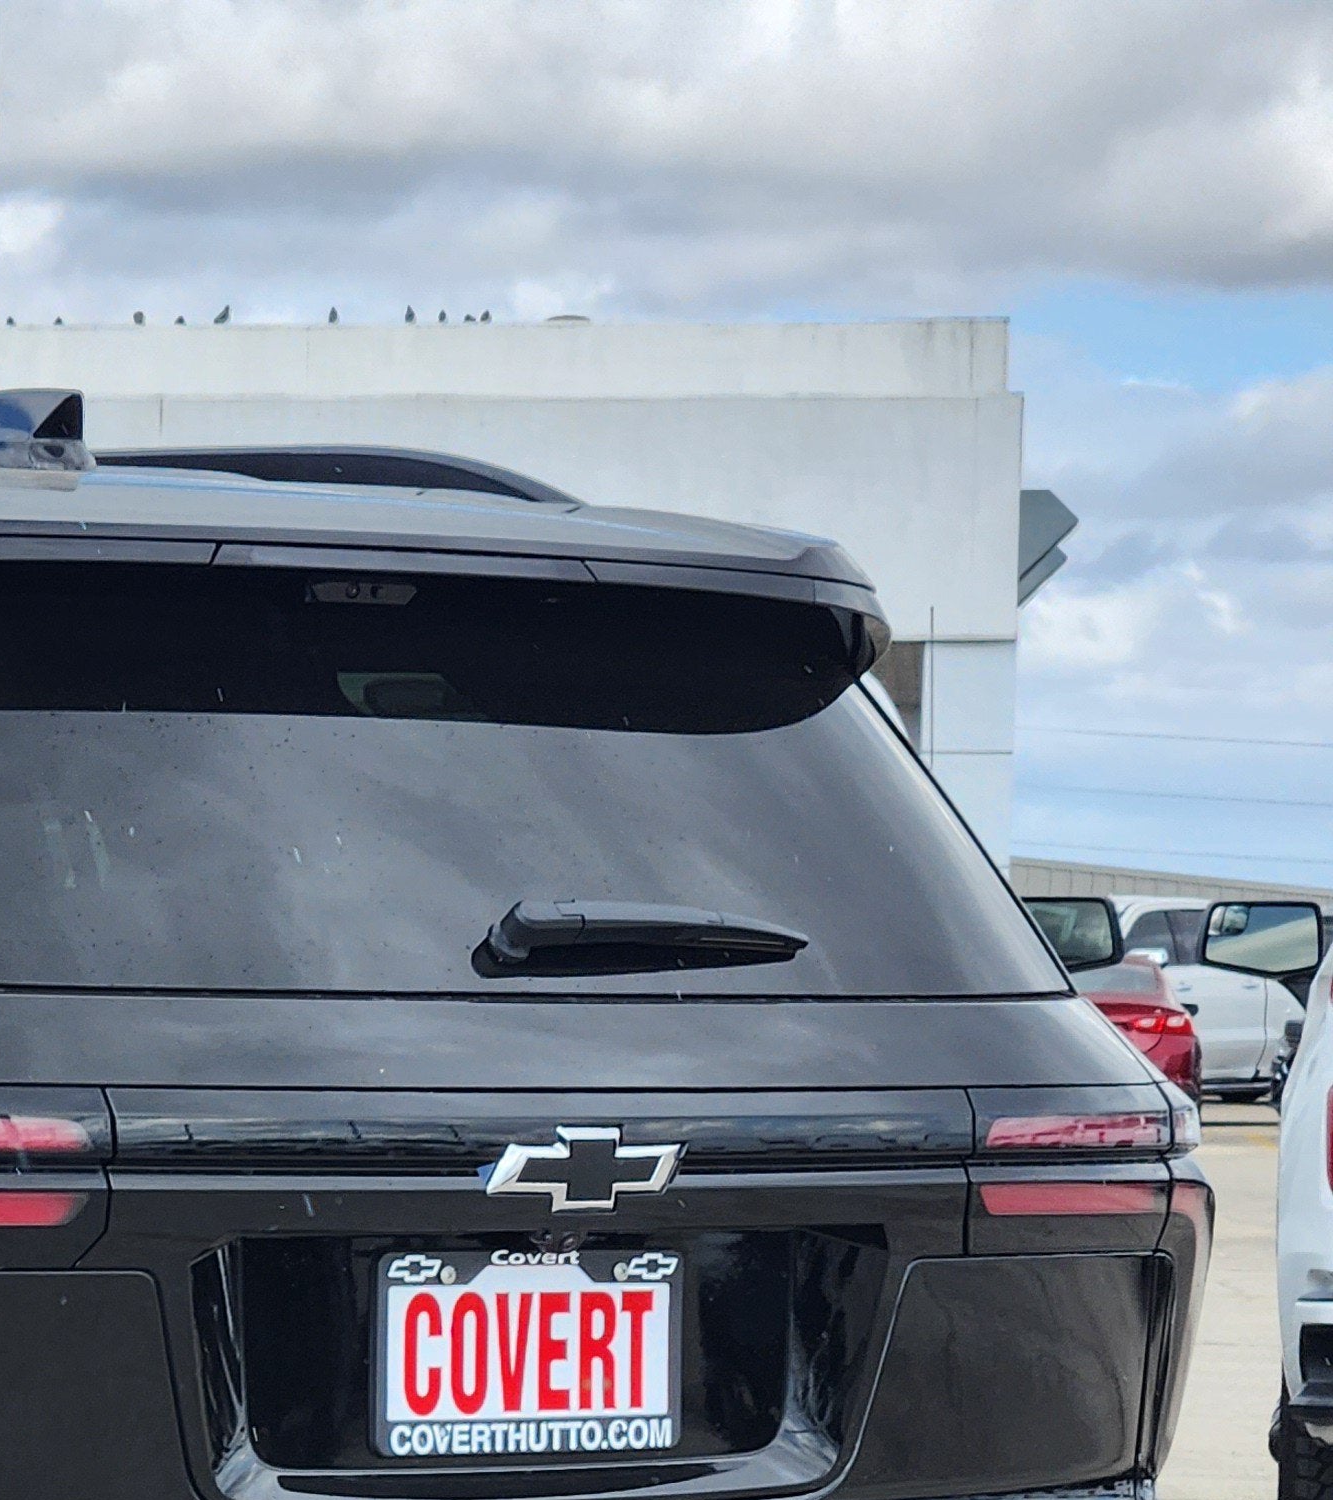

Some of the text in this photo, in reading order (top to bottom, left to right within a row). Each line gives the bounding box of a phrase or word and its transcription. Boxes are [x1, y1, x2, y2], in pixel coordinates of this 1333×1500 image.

[490, 1249, 580, 1266] Covert
[404, 1290, 654, 1415] COVERT
[390, 1418, 672, 1456] COVERTHUTTO.COM
